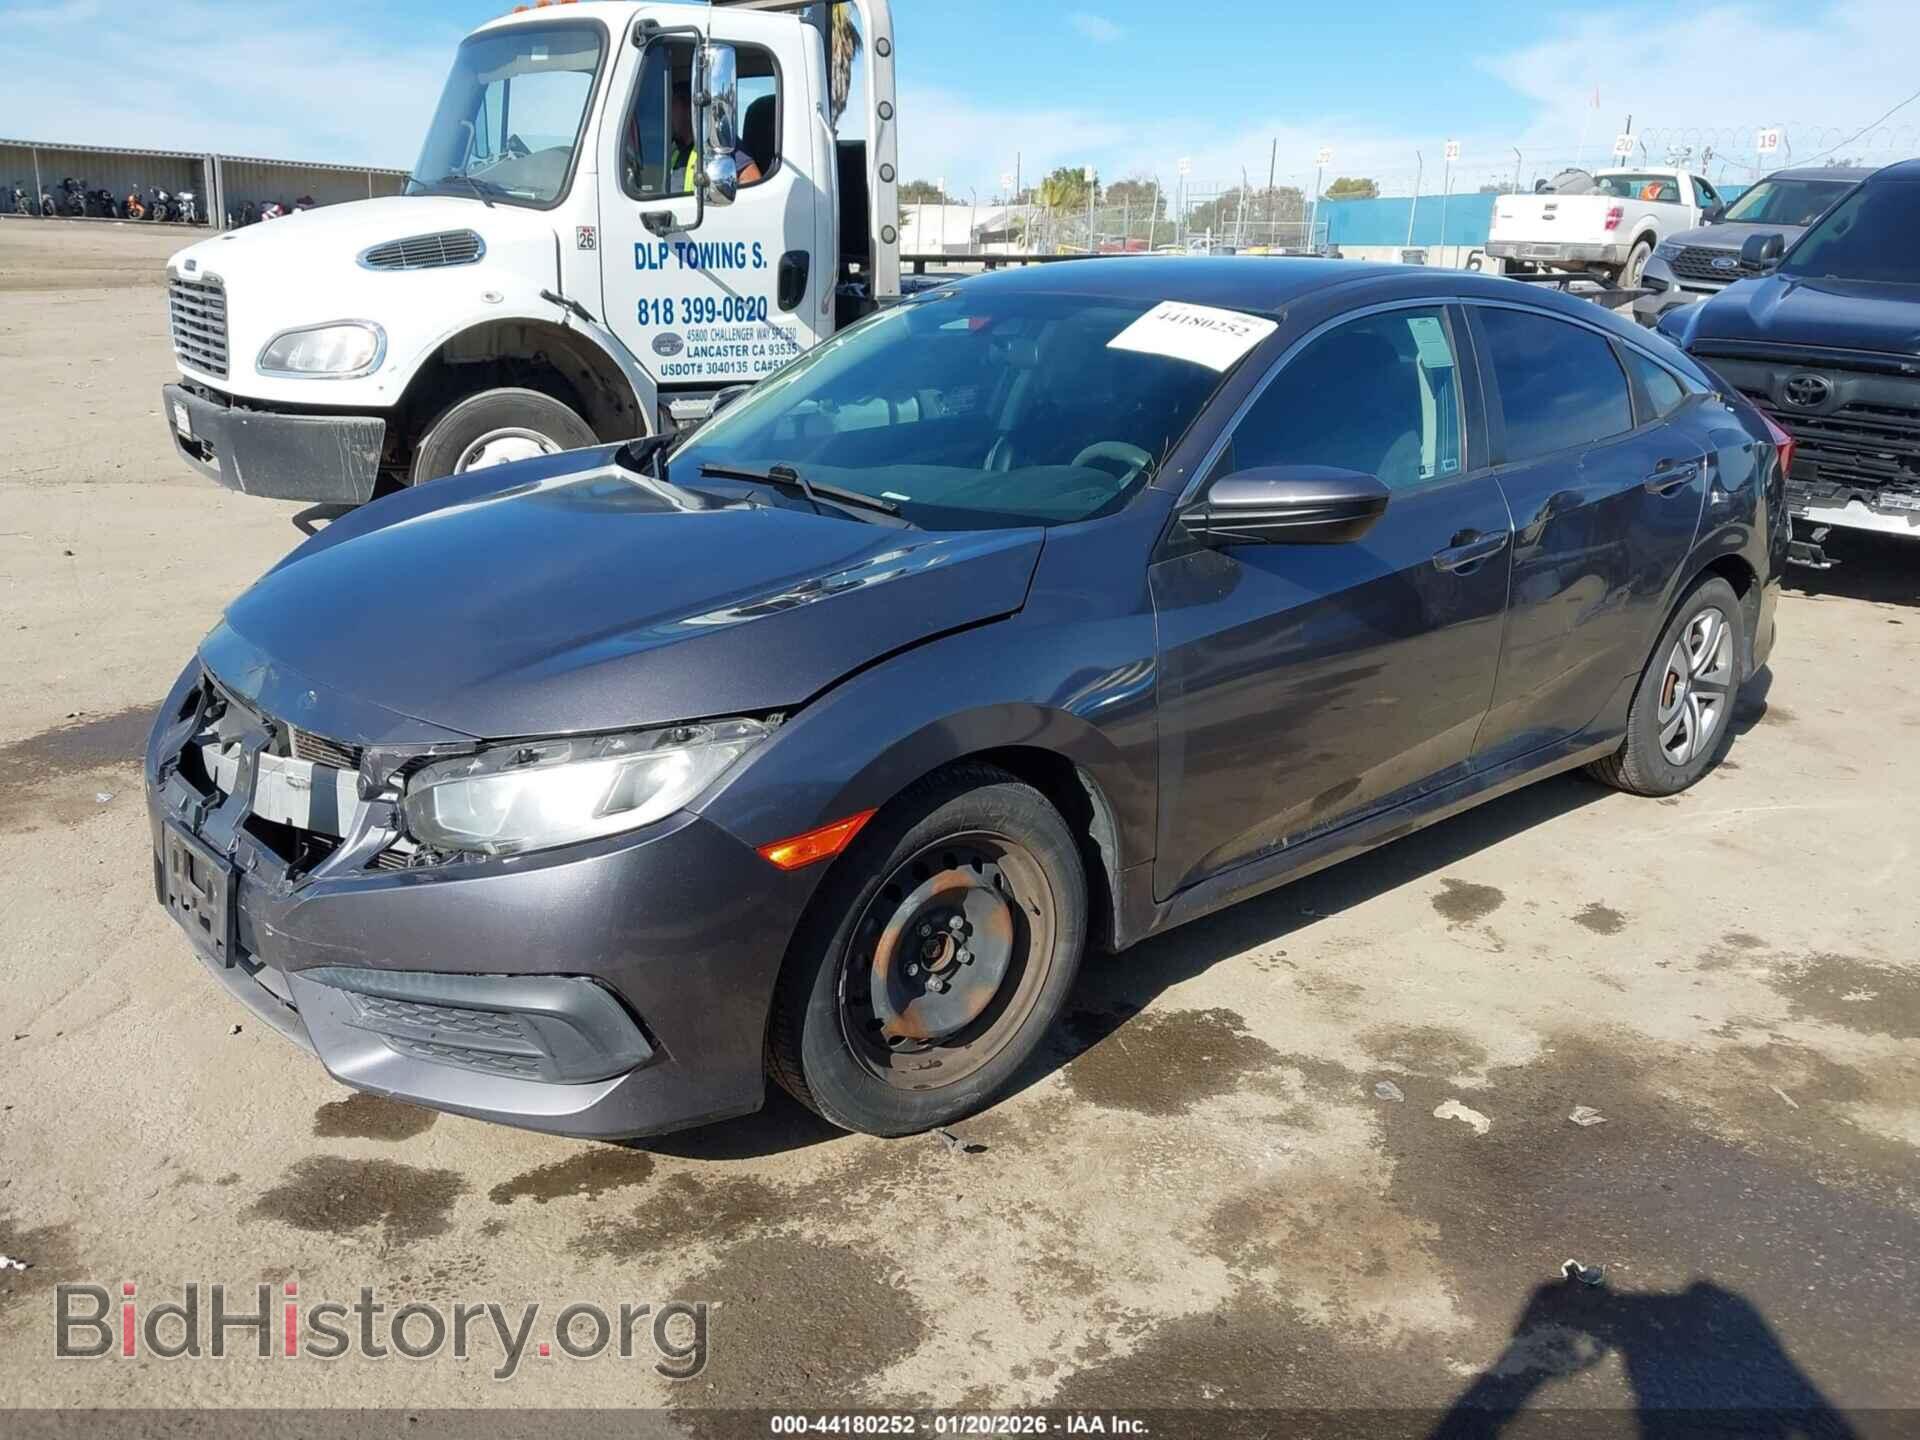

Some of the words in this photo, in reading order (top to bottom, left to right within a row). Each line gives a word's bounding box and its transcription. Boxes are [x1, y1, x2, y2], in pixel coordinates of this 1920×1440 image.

[1615, 138, 1634, 153] 20
[1760, 134, 1777, 148] 19
[580, 232, 594, 249] 26
[634, 242, 669, 270] DLP
[675, 242, 746, 269] TOWING
[752, 242, 768, 269] S.
[637, 298, 674, 326] 818
[681, 295, 768, 325] 399-0620
[1158, 311, 1251, 337] 44180252
[711, 327, 754, 342] CHALLENGER
[687, 344, 749, 358] LANCASTER
[752, 344, 766, 357] CA
[768, 342, 798, 356] 93535
[660, 363, 703, 377] USDOT#
[706, 361, 749, 375] 3040135
